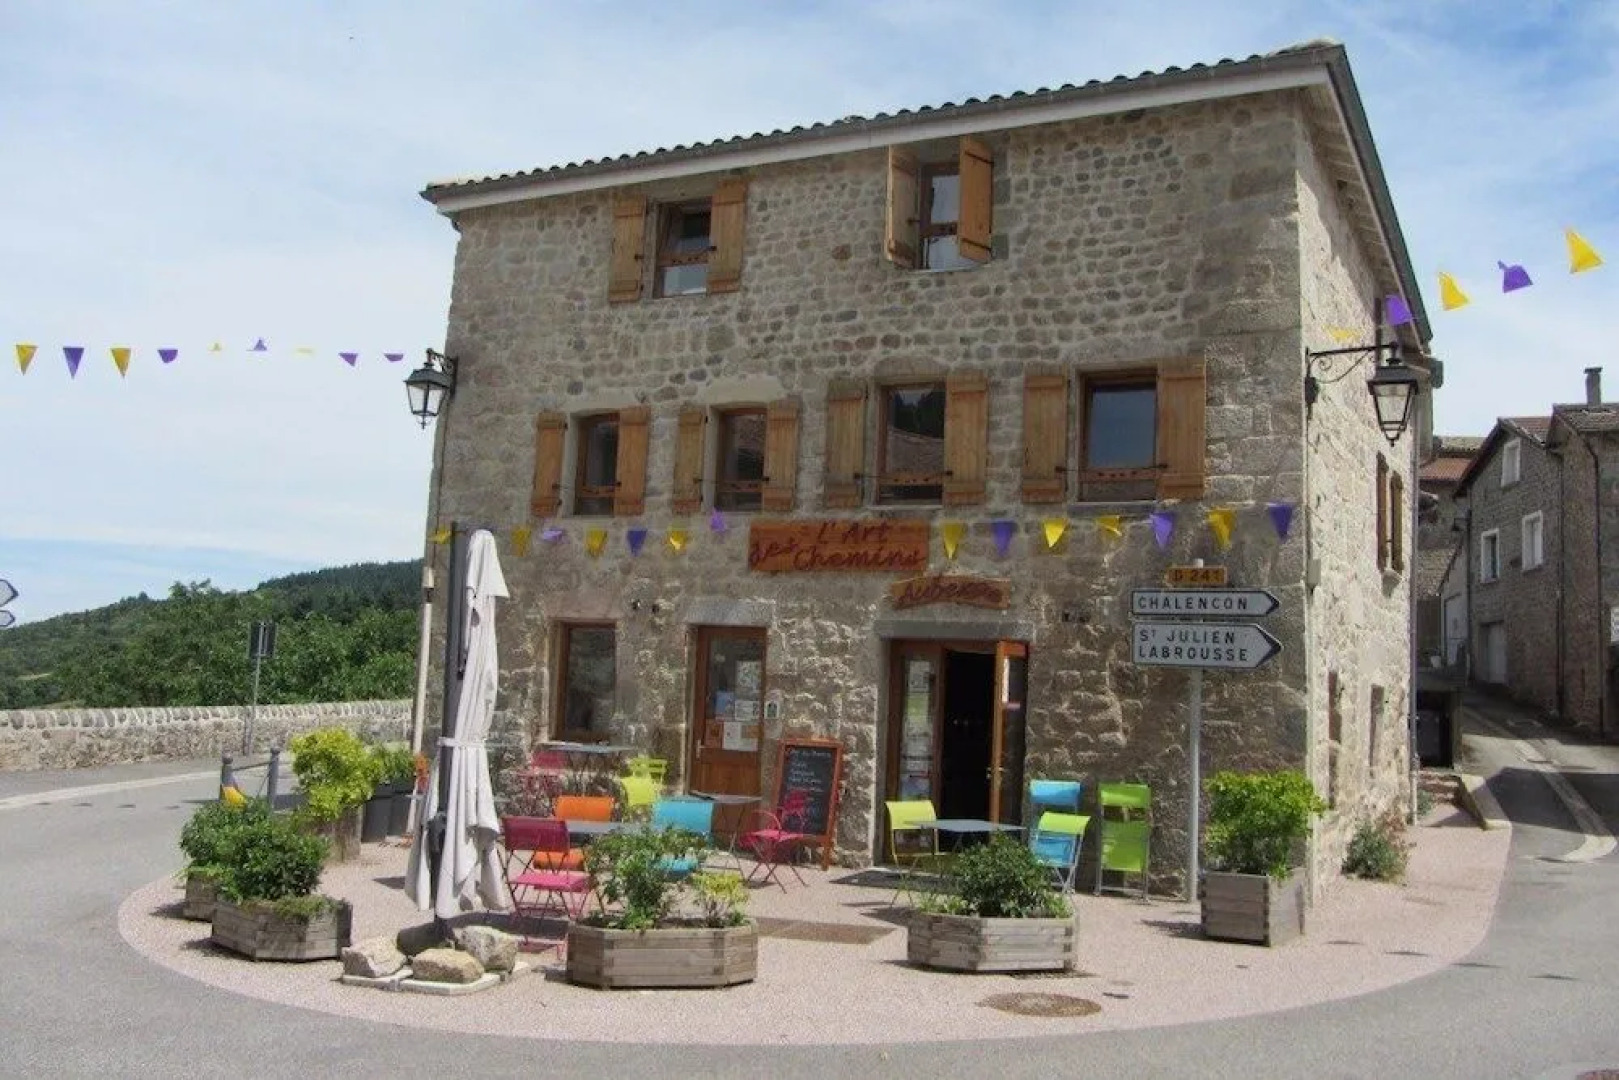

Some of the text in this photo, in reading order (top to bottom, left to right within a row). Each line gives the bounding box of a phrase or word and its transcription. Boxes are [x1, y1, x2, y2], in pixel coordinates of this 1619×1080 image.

[817, 520, 892, 545] L'Art
[793, 545, 927, 571] Chemins
[1172, 569, 1183, 582] D
[1138, 596, 1248, 611] CHALENCON
[1166, 631, 1235, 644] JULIEN
[1138, 645, 1248, 662] LABROUSSE
